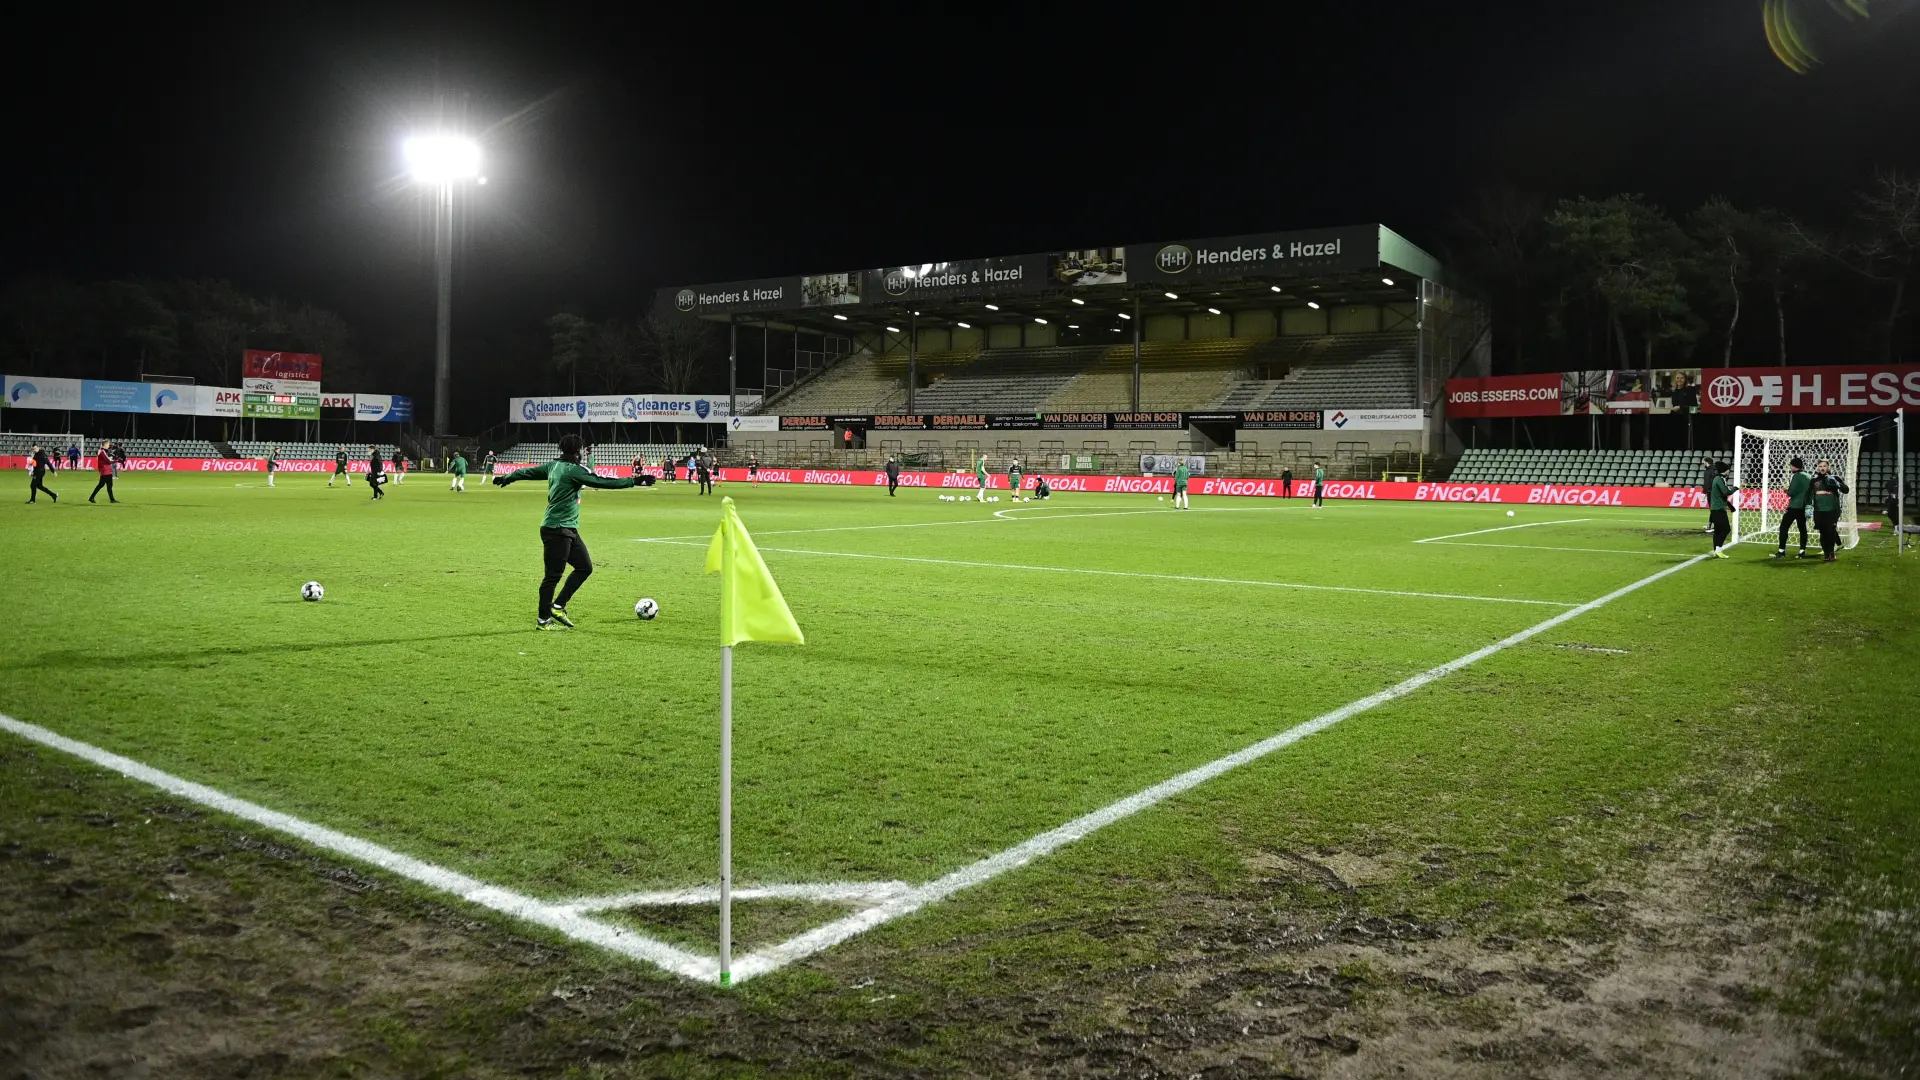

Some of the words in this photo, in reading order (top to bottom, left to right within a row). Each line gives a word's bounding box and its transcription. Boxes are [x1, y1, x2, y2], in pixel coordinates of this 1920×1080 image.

[1196, 246, 1266, 264] Henders
[1272, 244, 1284, 259] &
[1290, 238, 1341, 258] Hazel
[914, 271, 967, 288] Henders
[971, 270, 980, 284] &
[984, 265, 1022, 283] Hazel
[699, 289, 740, 305] Henders
[742, 289, 750, 301] &
[753, 286, 783, 301] Hazel
[275, 370, 310, 379] logistics
[215, 391, 241, 403] APK
[1449, 387, 1559, 404] JOBS.ESSERS.COM
[321, 397, 351, 407] APK
[359, 402, 385, 411] Theuws
[536, 400, 574, 412] cleaners
[636, 397, 691, 411] cleaners
[255, 404, 284, 414] PLUS
[587, 408, 619, 417] Bioprotection
[782, 416, 827, 426] DERDAELE
[874, 415, 924, 426] DERDAELE
[933, 414, 986, 426] DERDAELE
[1043, 413, 1061, 423] VAN
[1062, 413, 1079, 423] DEN
[1080, 413, 1103, 423] BOER
[1113, 413, 1133, 422] VAN
[1134, 413, 1152, 422] DEN
[1153, 412, 1178, 422] BOER
[1243, 411, 1265, 422] VAN
[1266, 411, 1287, 422] DEN
[1289, 411, 1316, 422] BOER
[746, 470, 791, 483] BNGOAL
